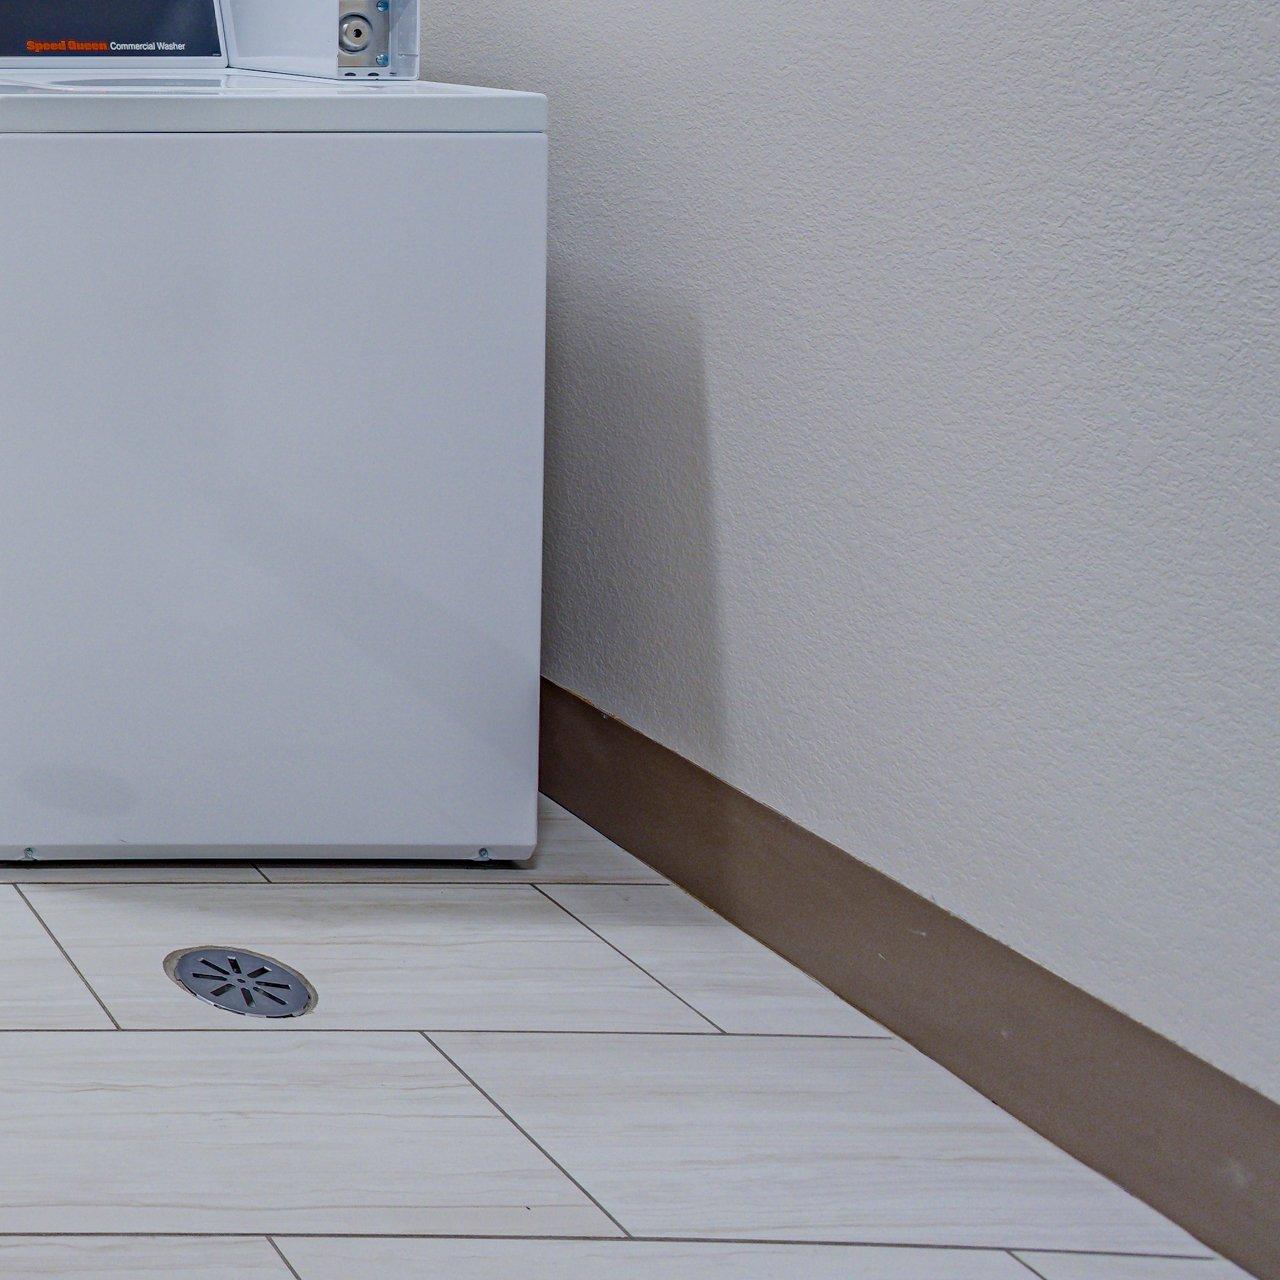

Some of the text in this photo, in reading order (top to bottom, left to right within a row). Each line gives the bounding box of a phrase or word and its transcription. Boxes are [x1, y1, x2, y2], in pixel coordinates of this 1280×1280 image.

[26, 40, 186, 53] Speed Queen Commercial Washer
